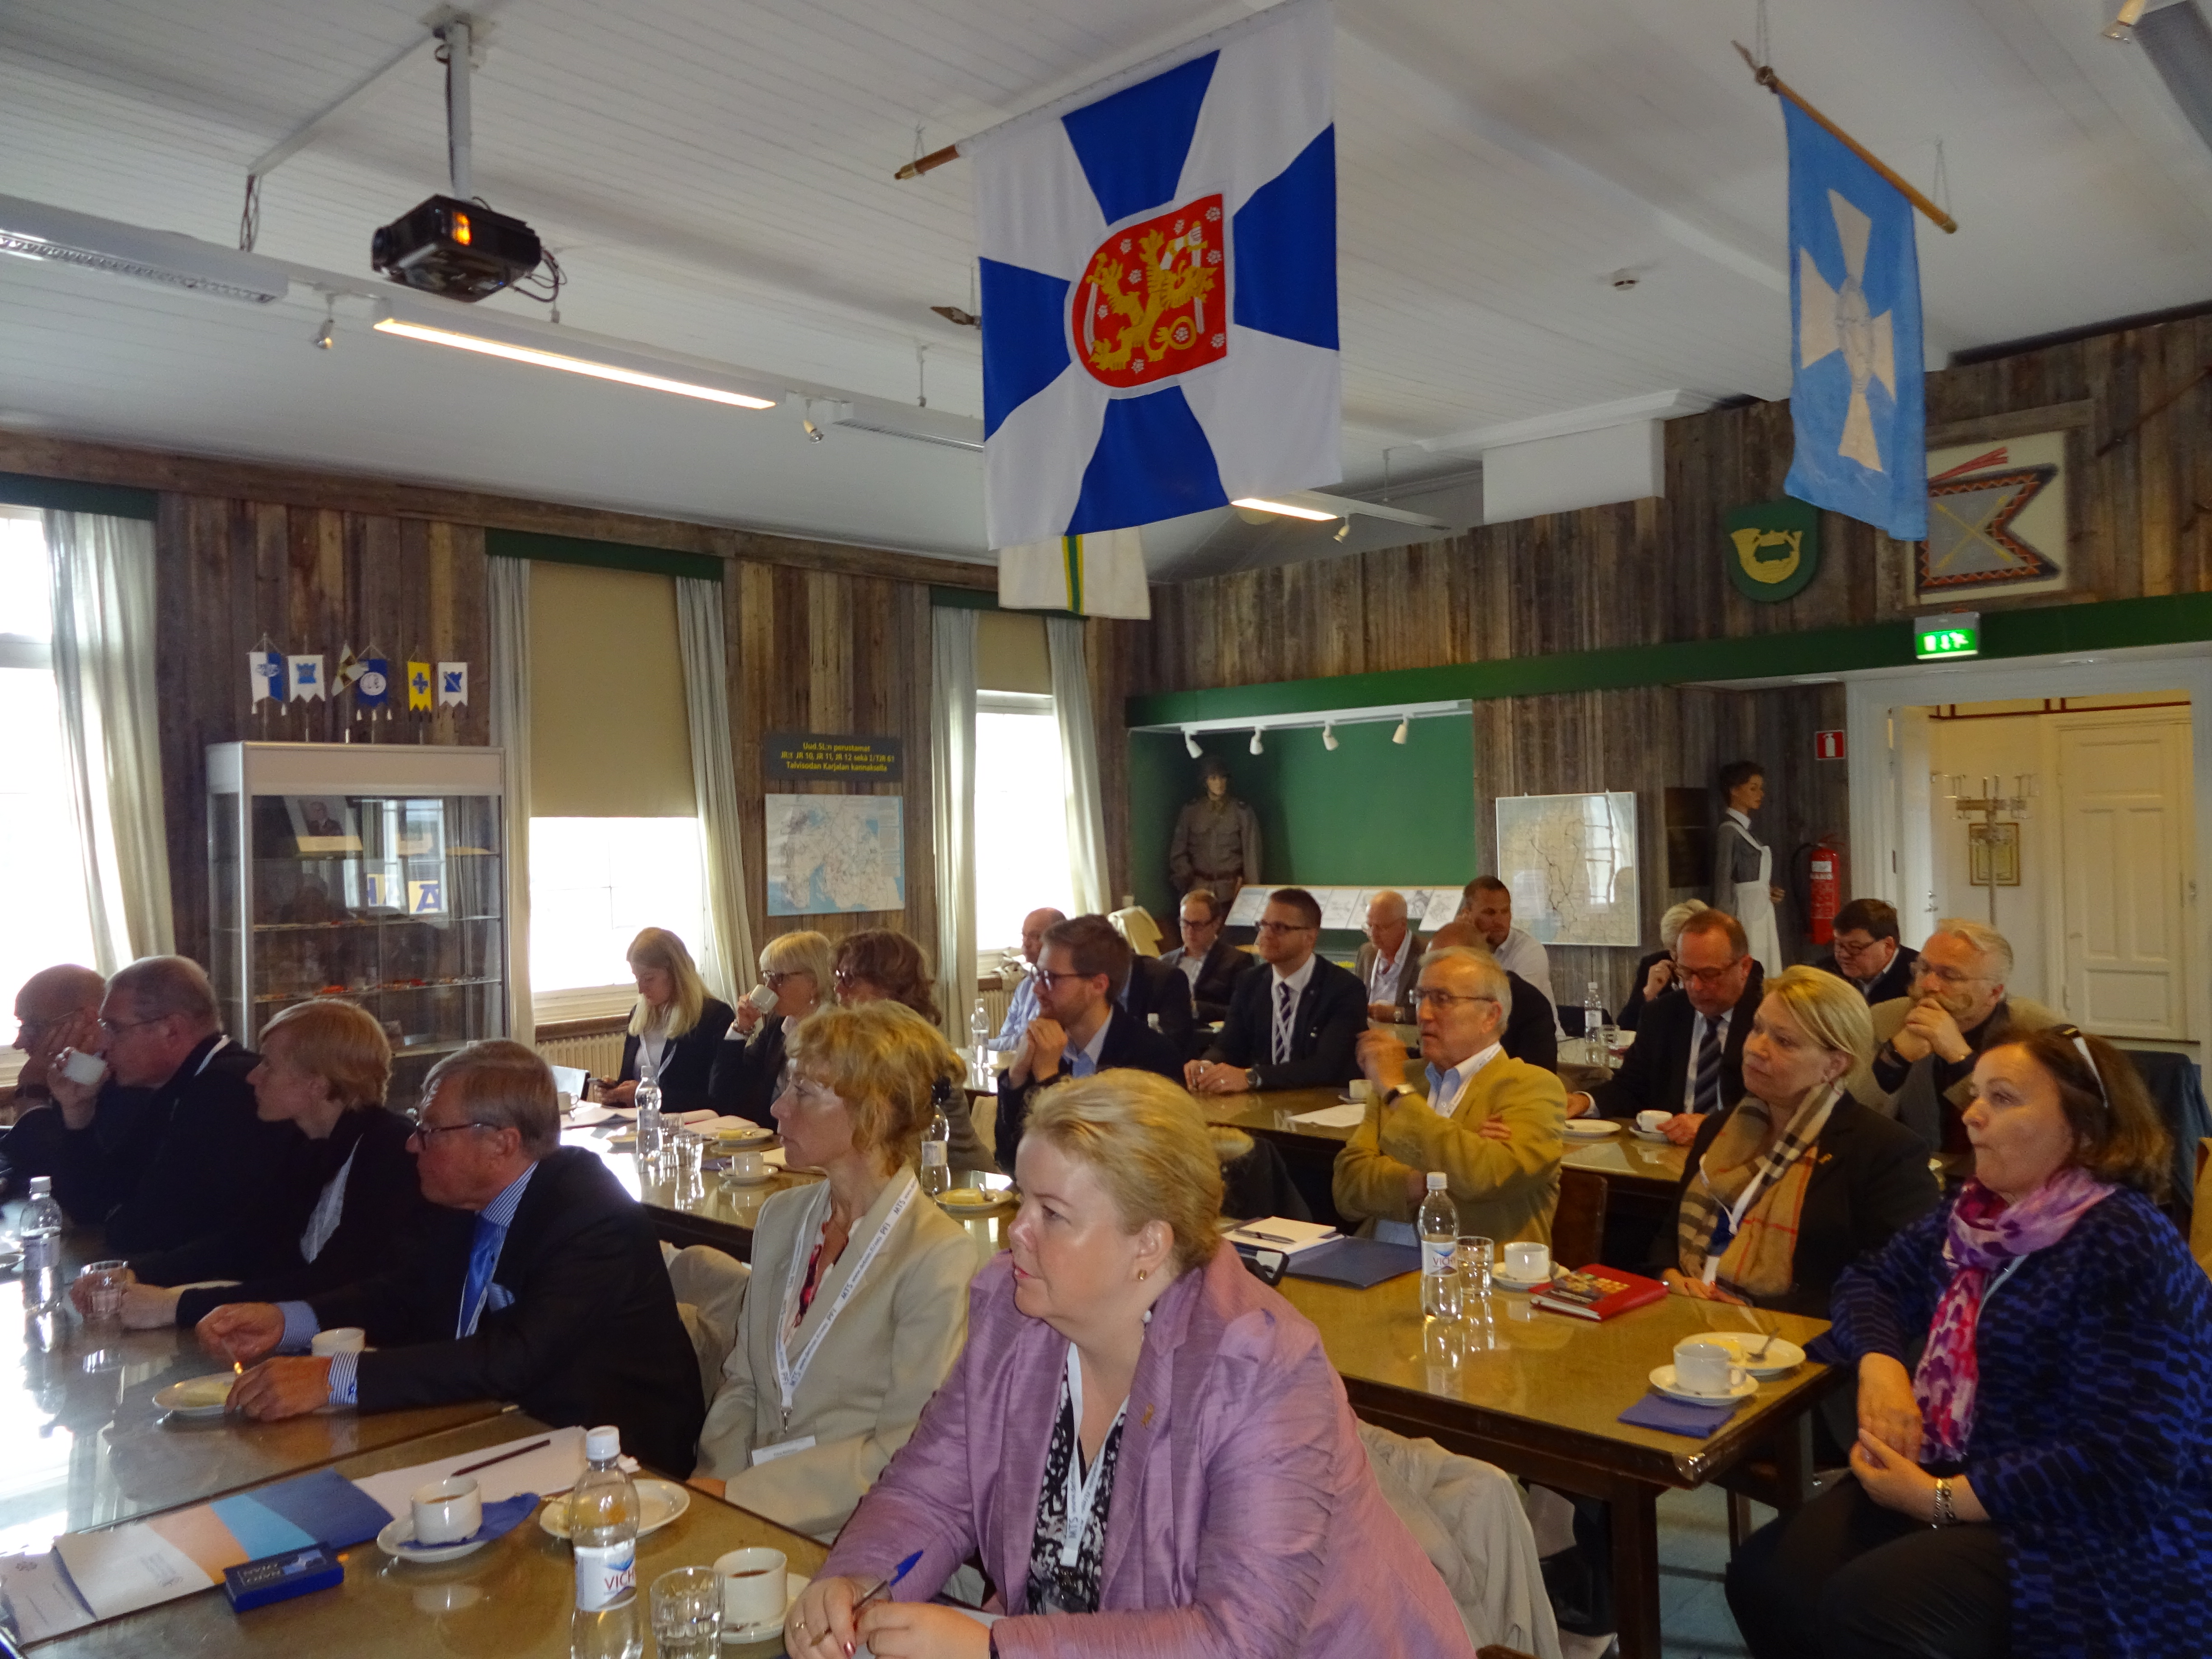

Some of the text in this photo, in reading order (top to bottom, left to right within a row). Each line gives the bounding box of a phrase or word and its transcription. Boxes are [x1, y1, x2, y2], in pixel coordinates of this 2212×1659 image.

[823, 762, 849, 771] Karjalan
[893, 1200, 906, 1214] MTS
[841, 1283, 853, 1300] MTS
[605, 1566, 635, 1589] VICH
